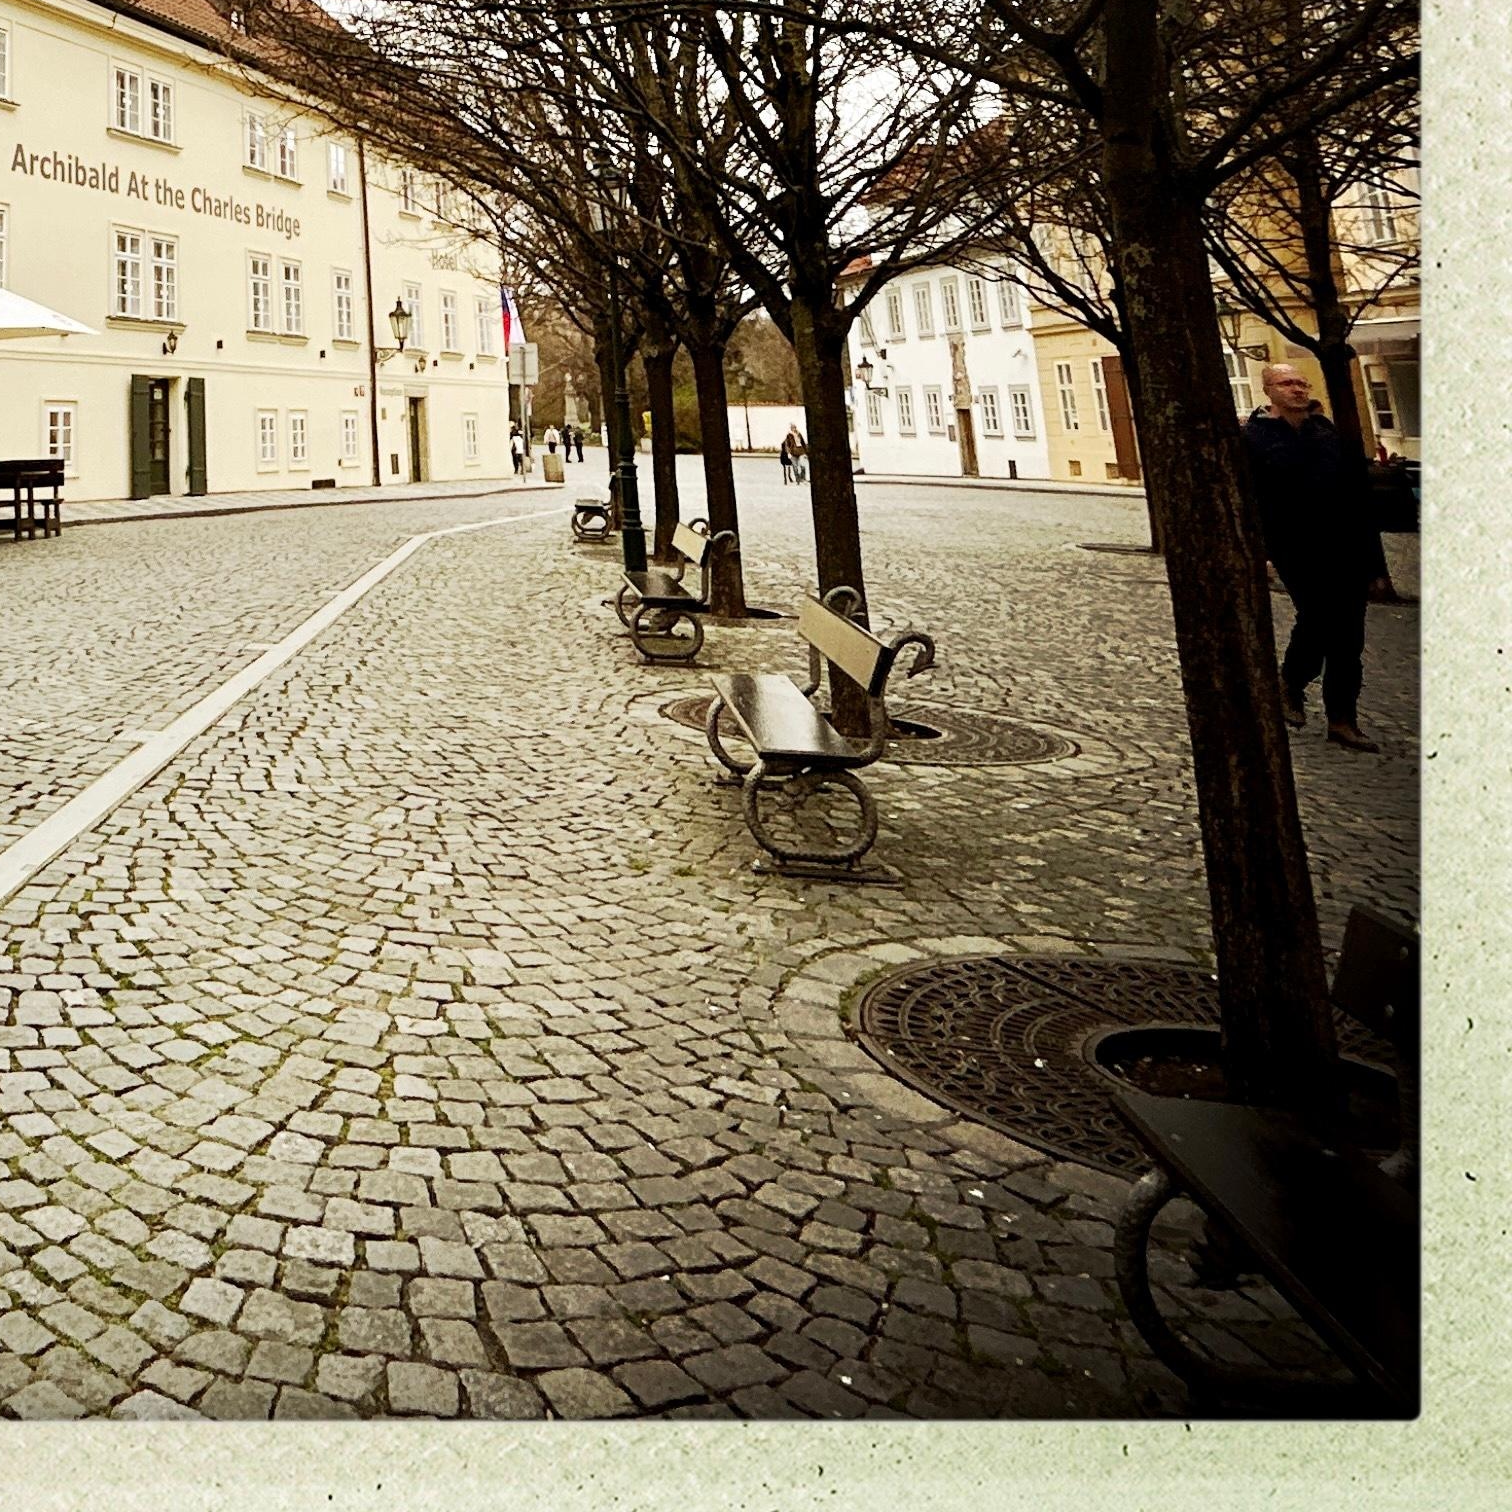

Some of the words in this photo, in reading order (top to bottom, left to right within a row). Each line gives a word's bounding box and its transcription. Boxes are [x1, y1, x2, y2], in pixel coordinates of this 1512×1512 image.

[11, 143, 119, 194] Archibald
[127, 170, 149, 201] At
[155, 178, 185, 210] the
[191, 187, 251, 225] Charles
[255, 203, 301, 240] Bridge
